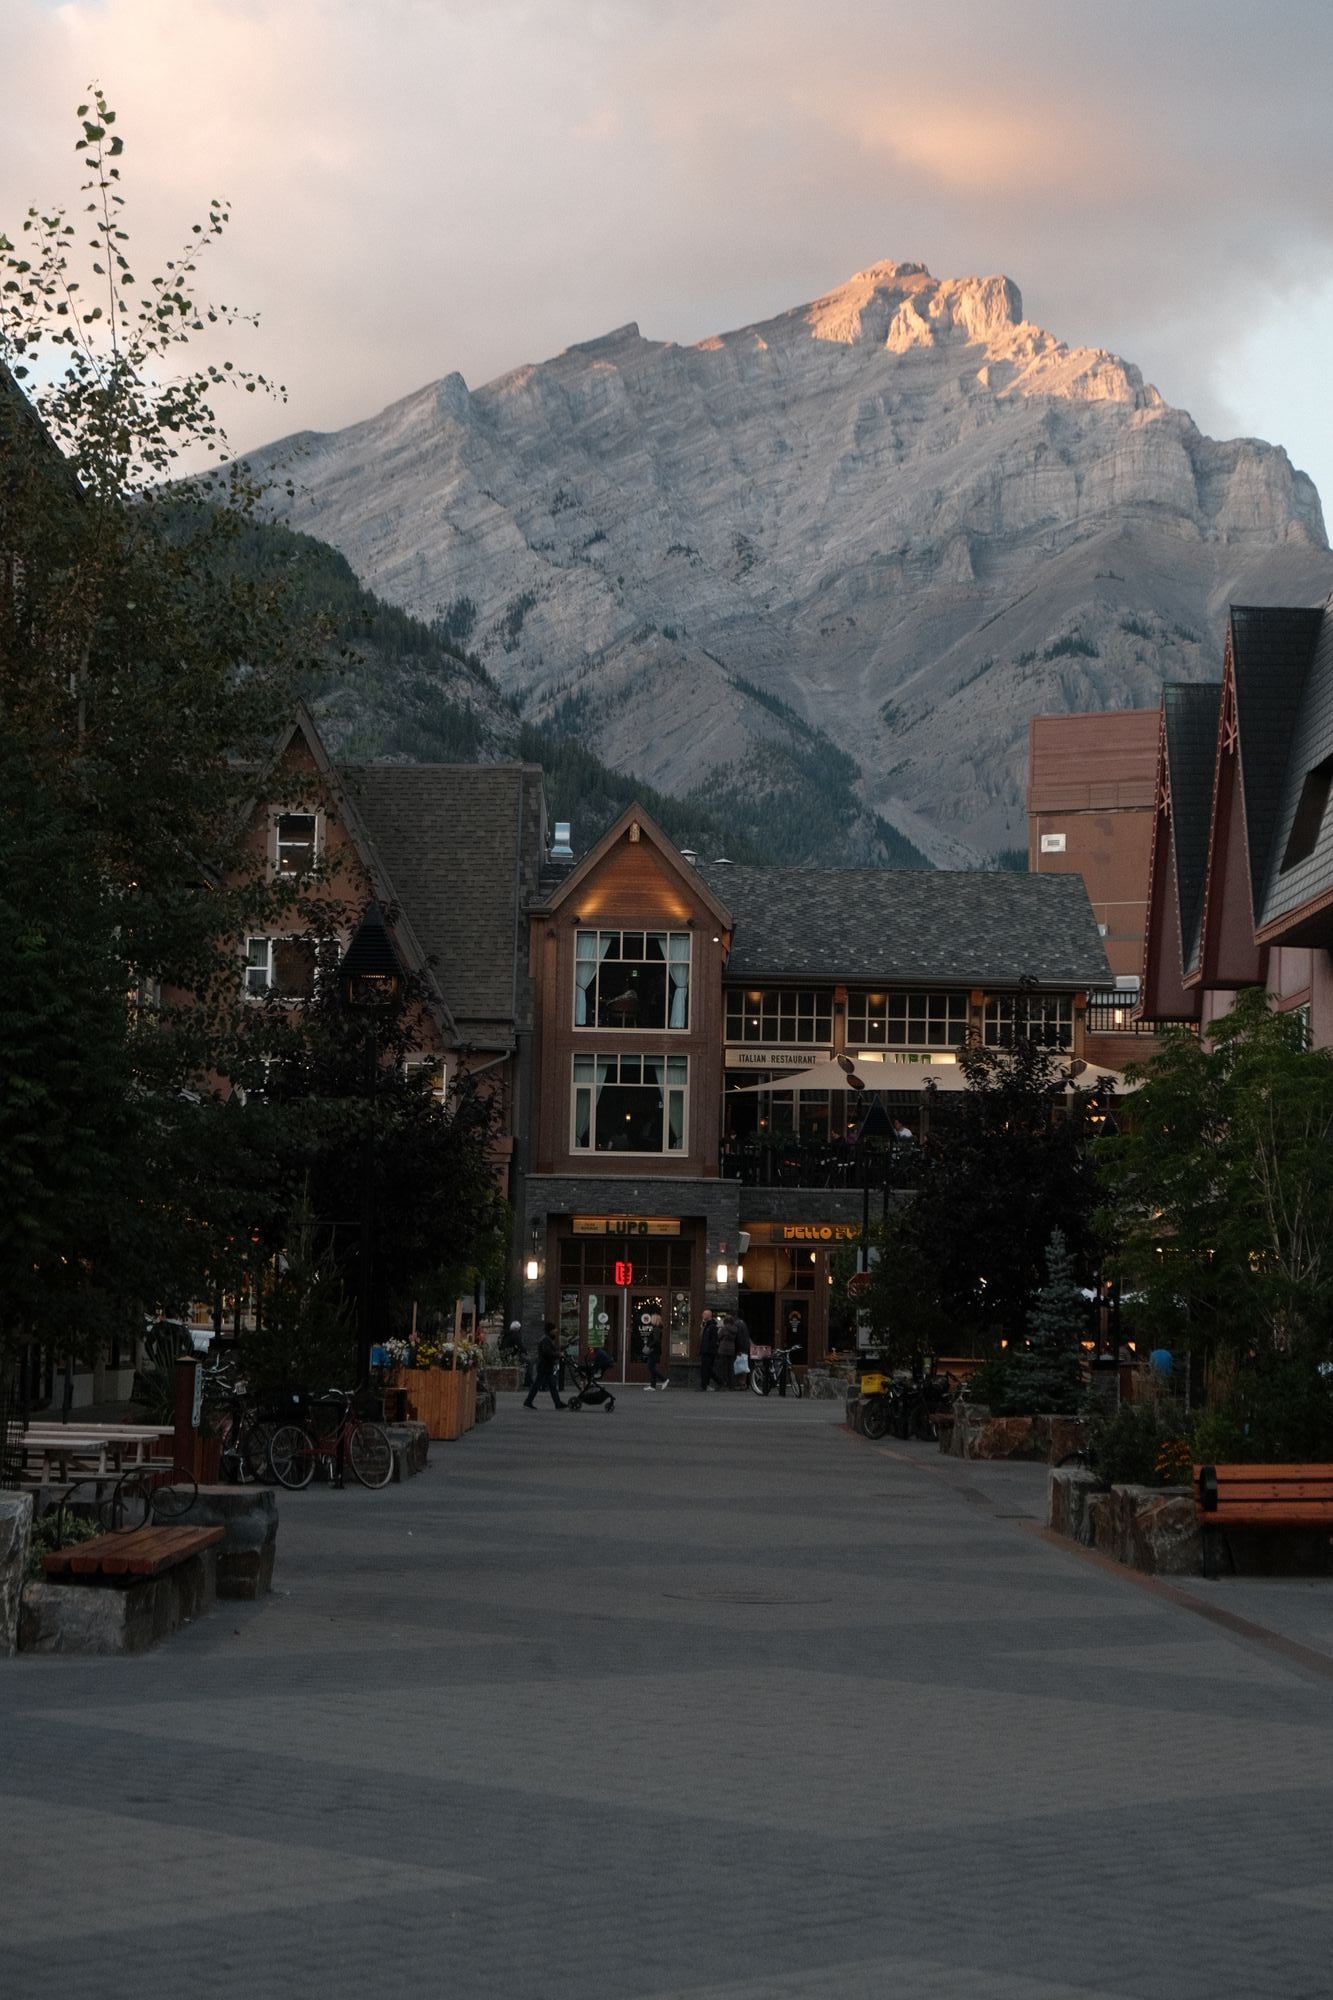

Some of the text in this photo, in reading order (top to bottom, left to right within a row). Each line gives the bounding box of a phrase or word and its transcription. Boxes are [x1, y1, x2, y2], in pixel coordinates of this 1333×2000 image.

[739, 1054, 816, 1064] ITALIAN RESTAURANT
[606, 1221, 648, 1234] LUPO
[784, 1226, 832, 1240] HELLO
